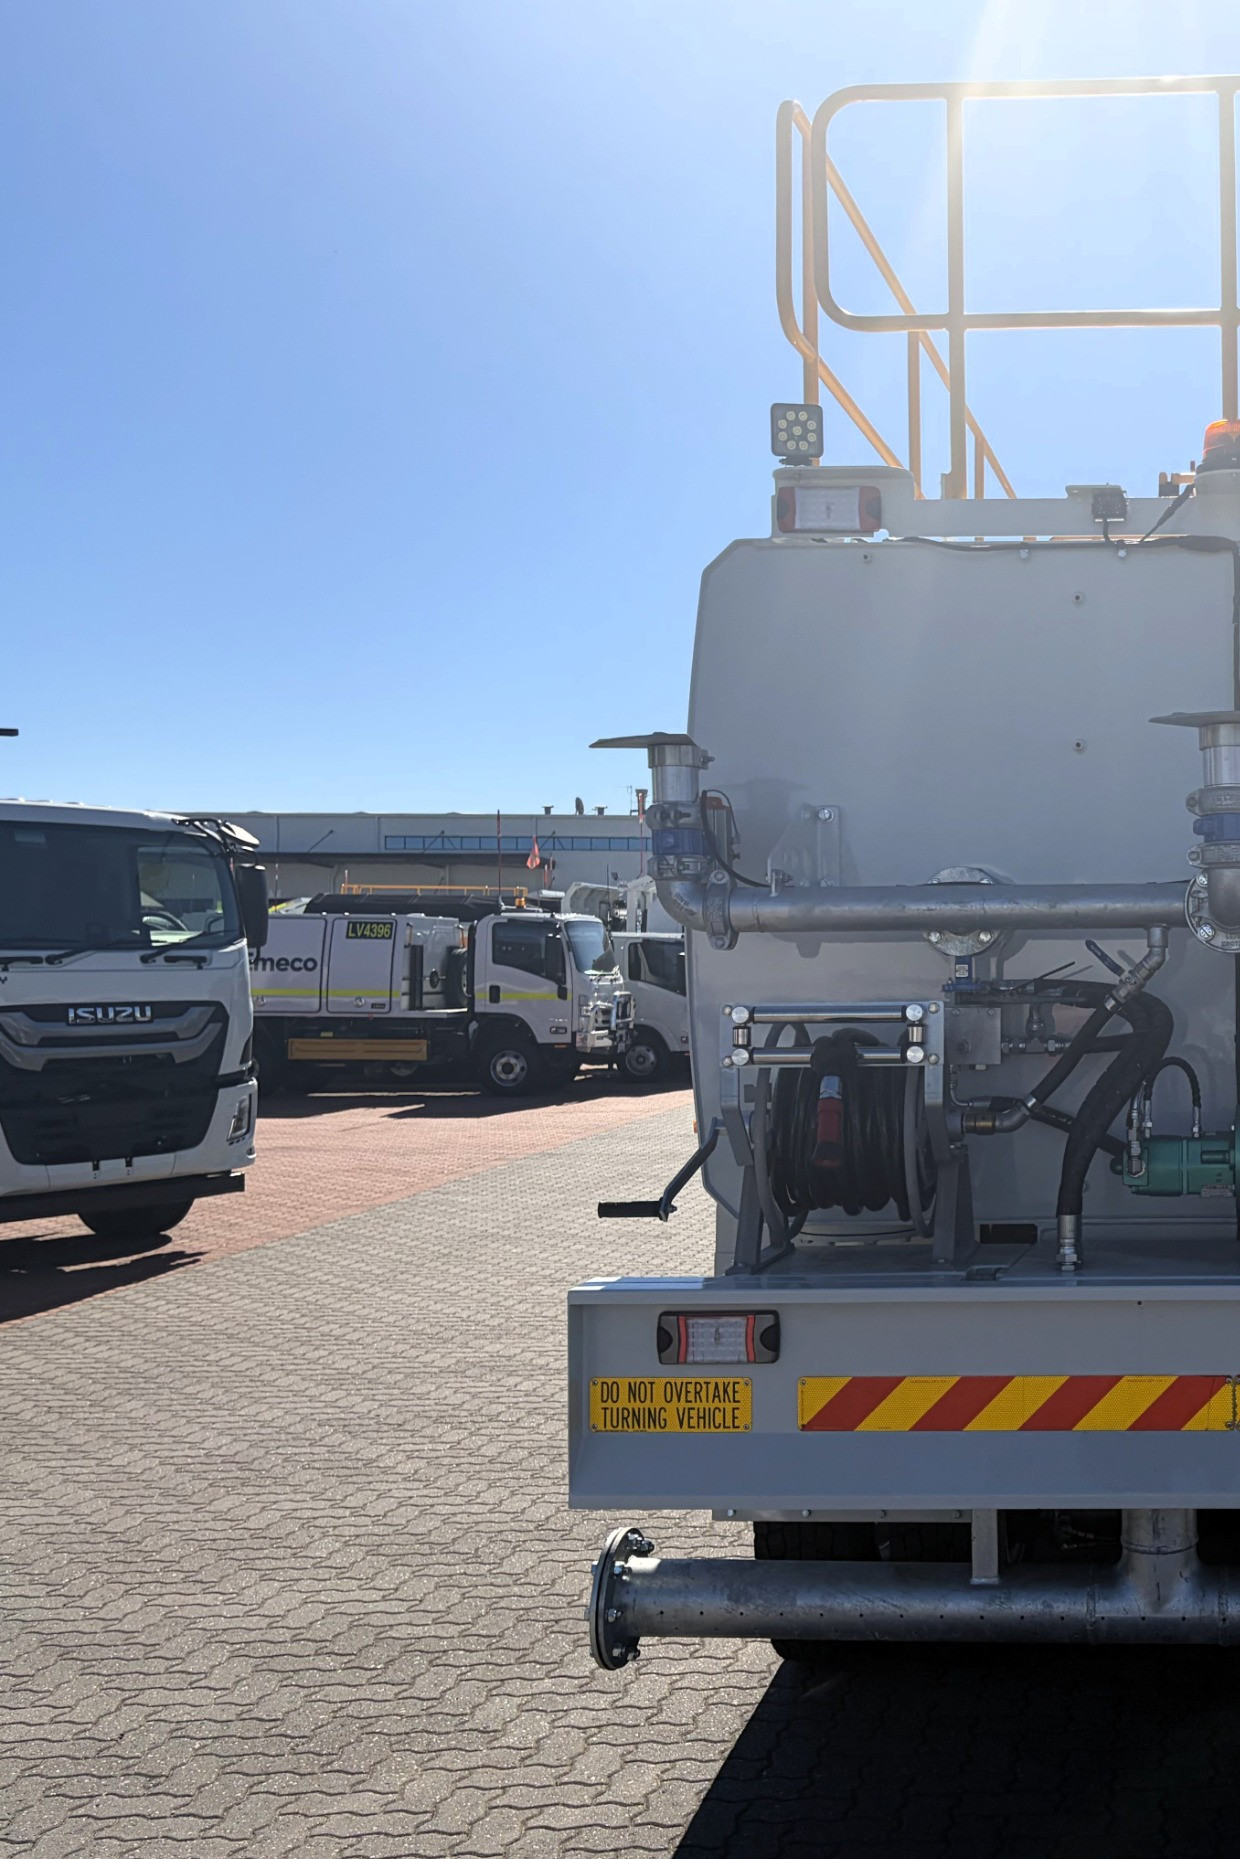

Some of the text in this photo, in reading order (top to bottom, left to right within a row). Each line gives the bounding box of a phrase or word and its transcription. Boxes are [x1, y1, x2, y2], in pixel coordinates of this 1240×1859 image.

[349, 923, 391, 938] LV4396
[249, 953, 318, 972] meco
[68, 1006, 152, 1024] ISUZU
[601, 1381, 741, 1404] DO NOT OVERTAKE
[601, 1407, 741, 1429] TURNING VEHICLE
